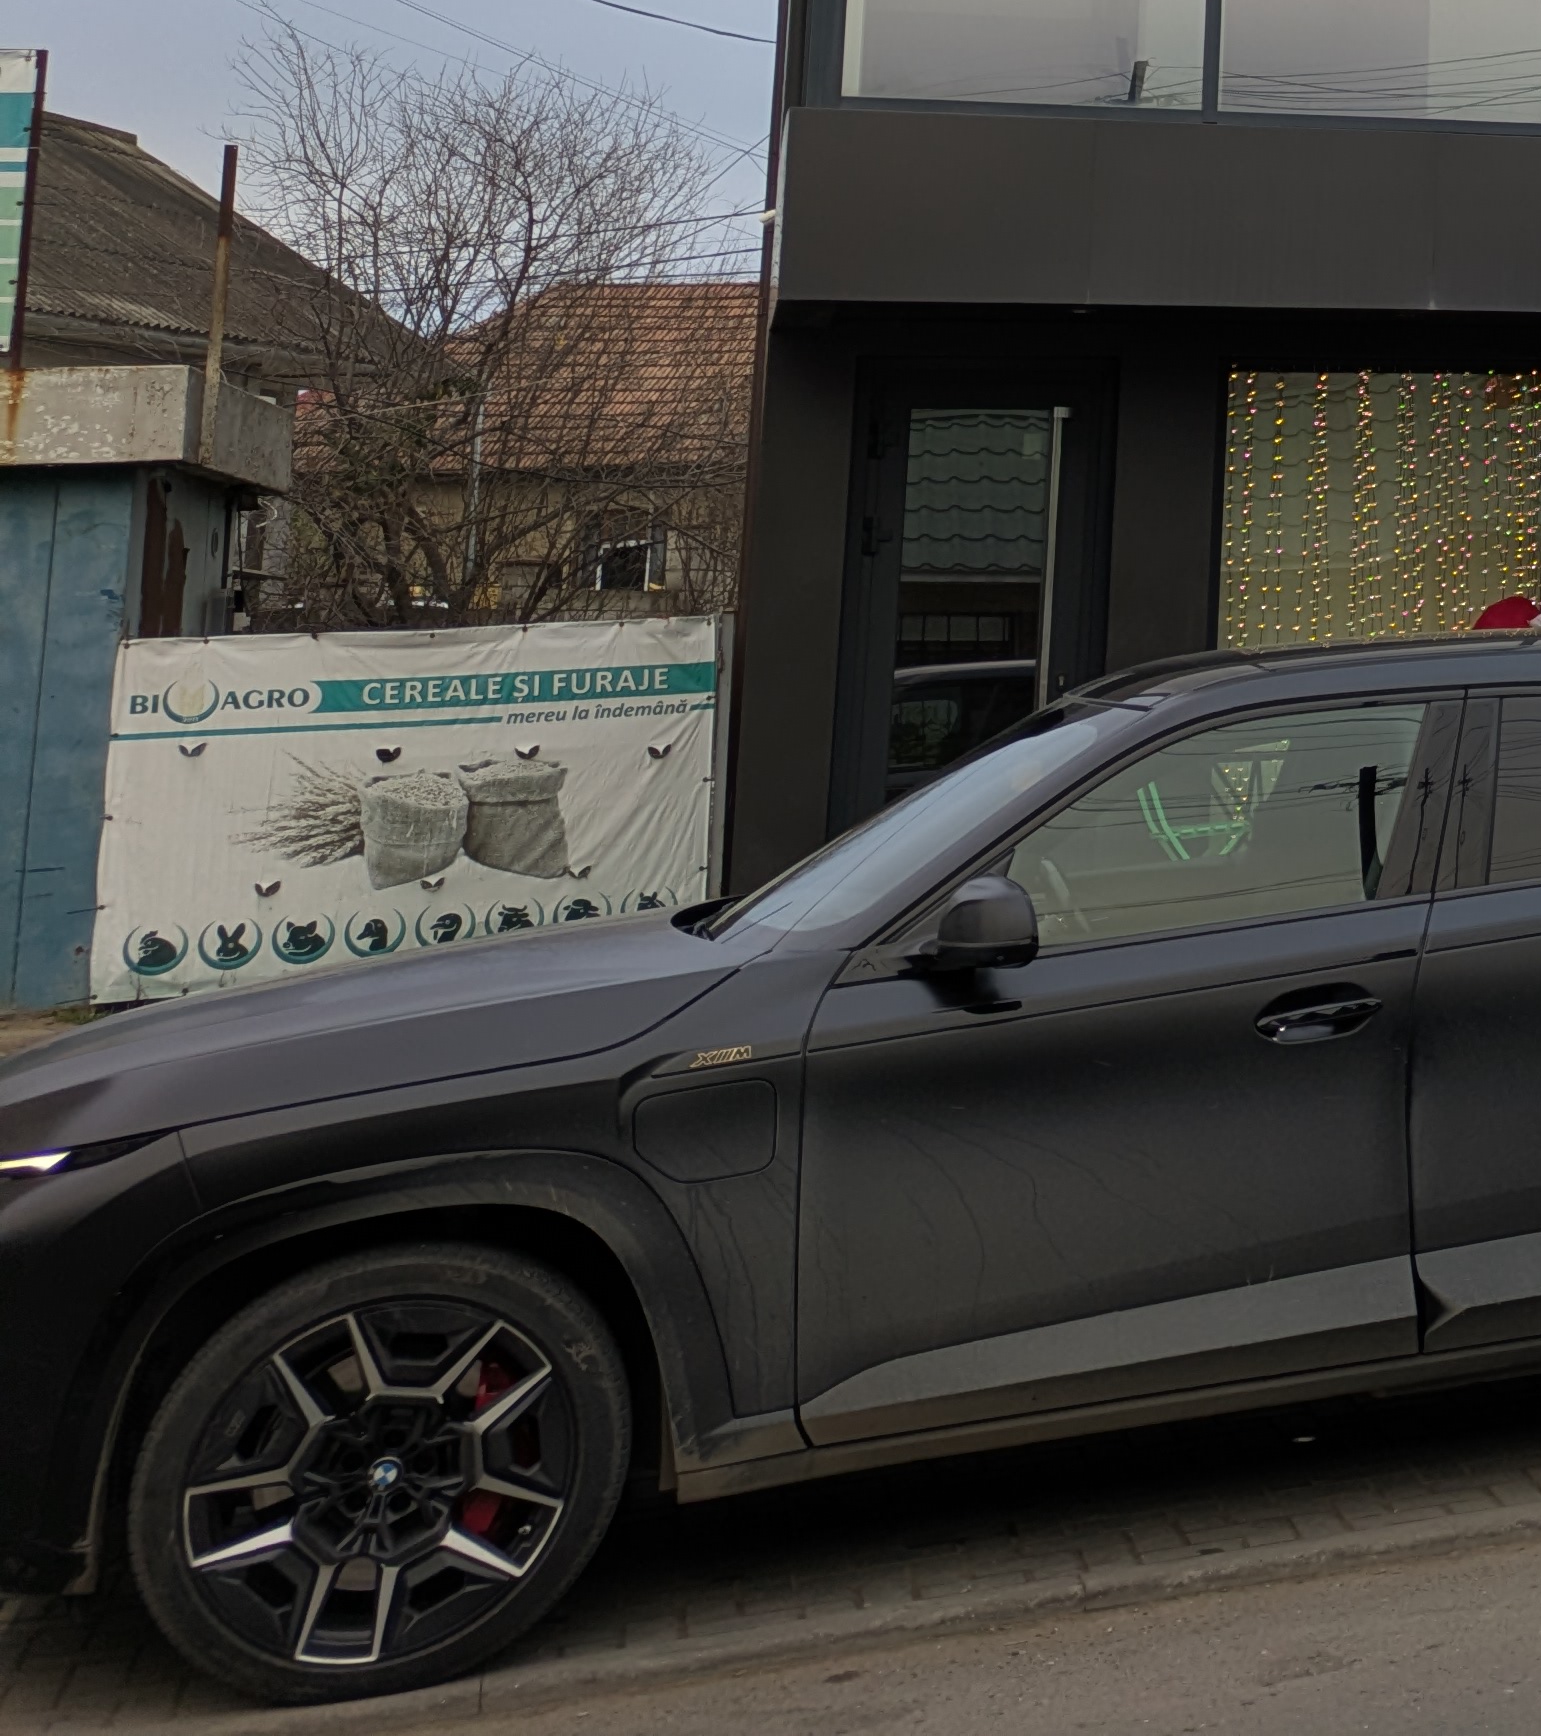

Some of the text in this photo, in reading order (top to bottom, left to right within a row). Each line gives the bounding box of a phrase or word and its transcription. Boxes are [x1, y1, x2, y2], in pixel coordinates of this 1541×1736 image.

[361, 676, 504, 706] CEREALE
[552, 668, 670, 697] FURAJE
[506, 699, 688, 726] mereu la îndemână
